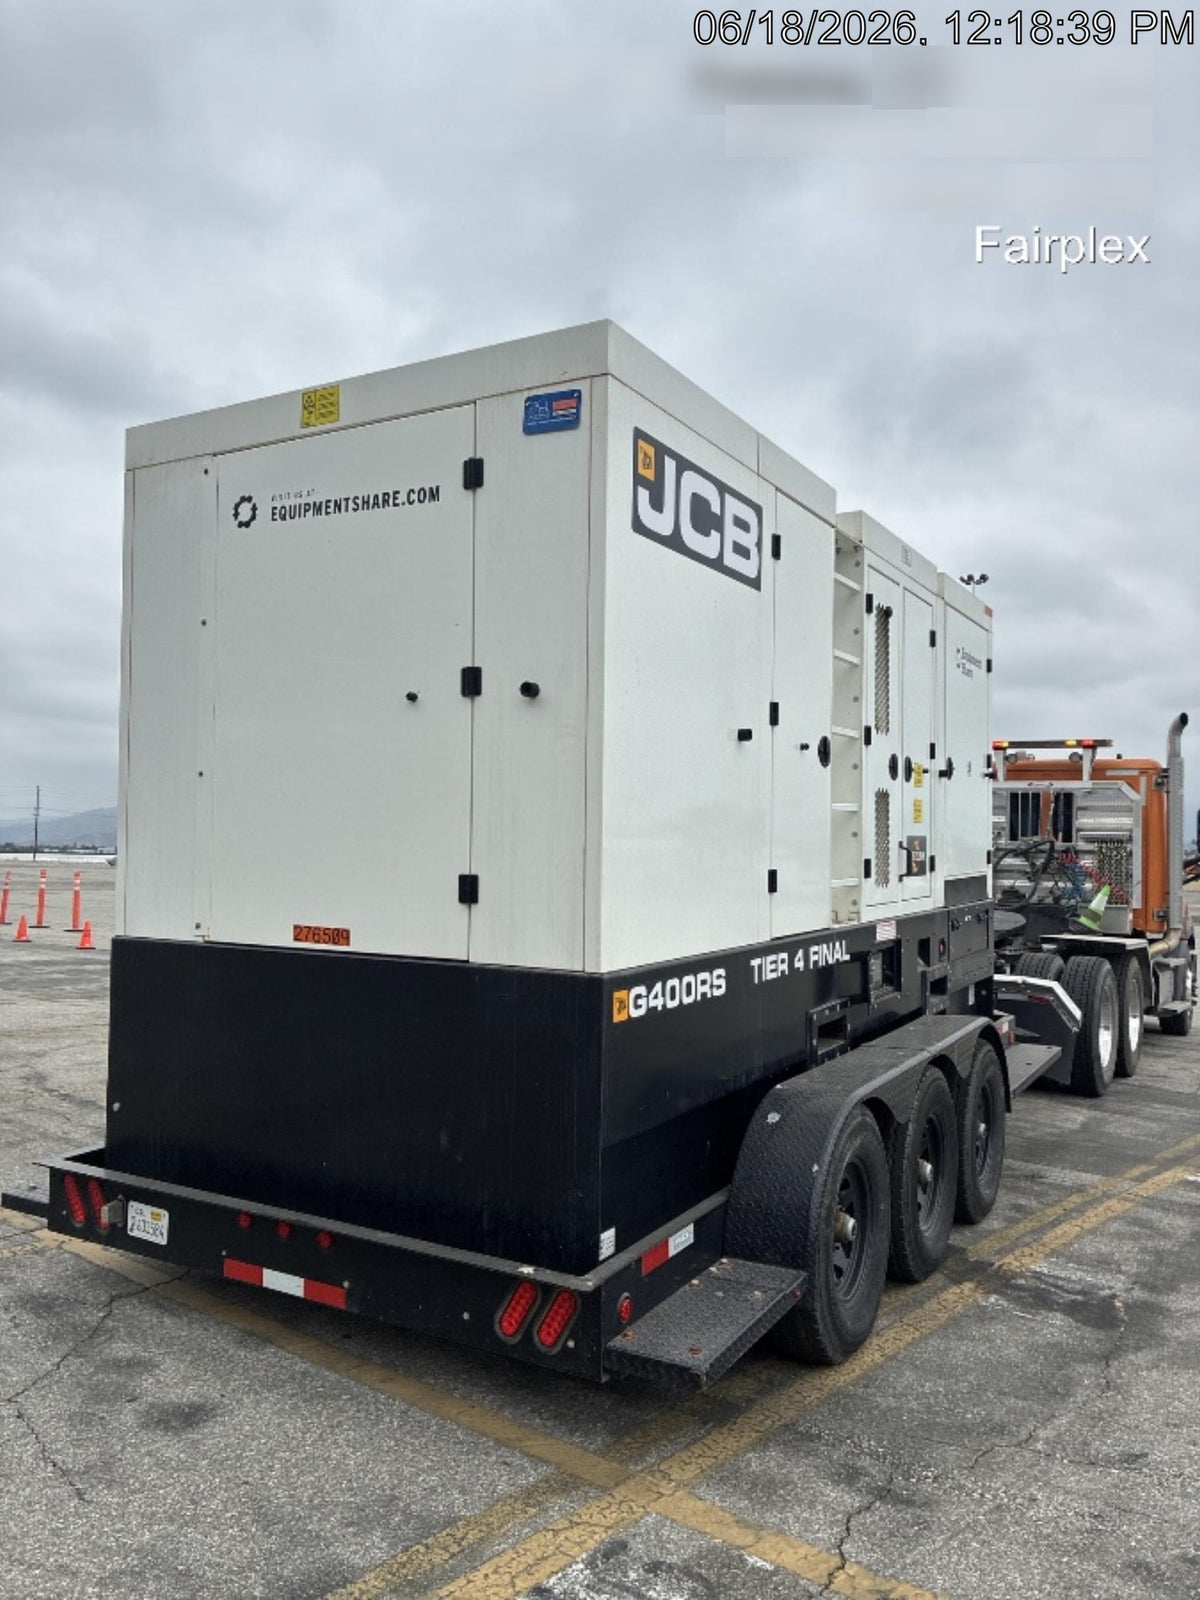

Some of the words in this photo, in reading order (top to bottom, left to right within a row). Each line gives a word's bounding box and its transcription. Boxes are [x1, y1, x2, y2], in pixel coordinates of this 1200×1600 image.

[271, 485, 441, 522] EQUIPMENTSHARE.COM
[637, 453, 761, 580] JCB
[750, 952, 789, 984] TIER
[794, 949, 804, 971] 4
[809, 940, 851, 969] FINAL
[629, 968, 726, 1018] G400RS
